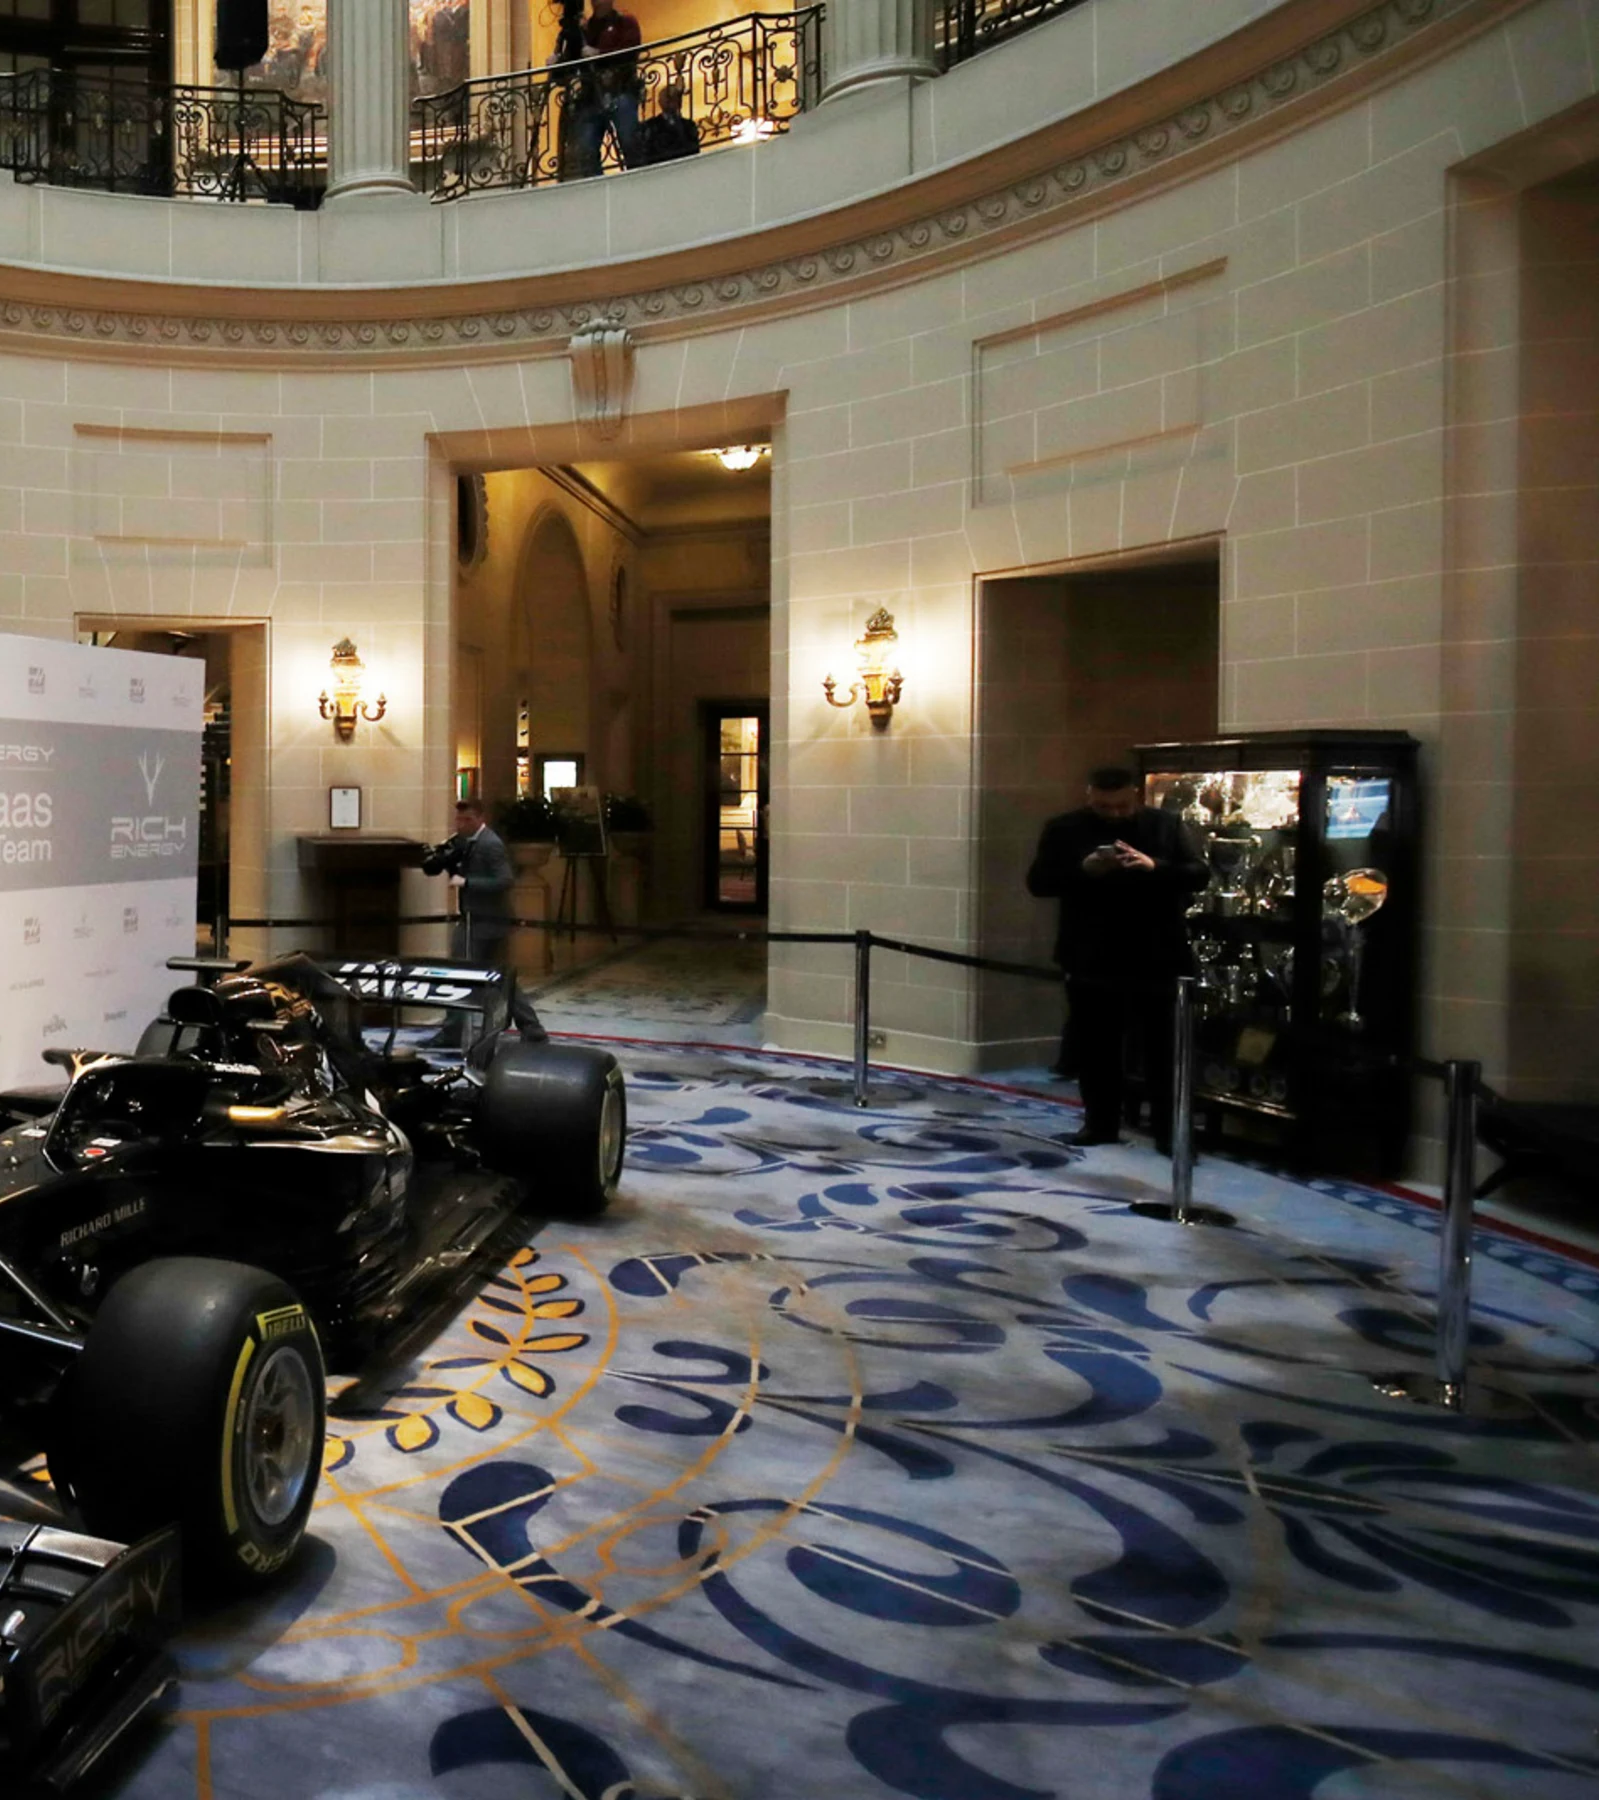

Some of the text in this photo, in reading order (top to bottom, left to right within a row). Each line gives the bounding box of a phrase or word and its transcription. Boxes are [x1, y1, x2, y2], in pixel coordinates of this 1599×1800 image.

[111, 816, 186, 842] RICH
[111, 841, 185, 859] ENERGY
[60, 1197, 146, 1248] RICHARD MILLE
[255, 1304, 306, 1341] PIRELLI
